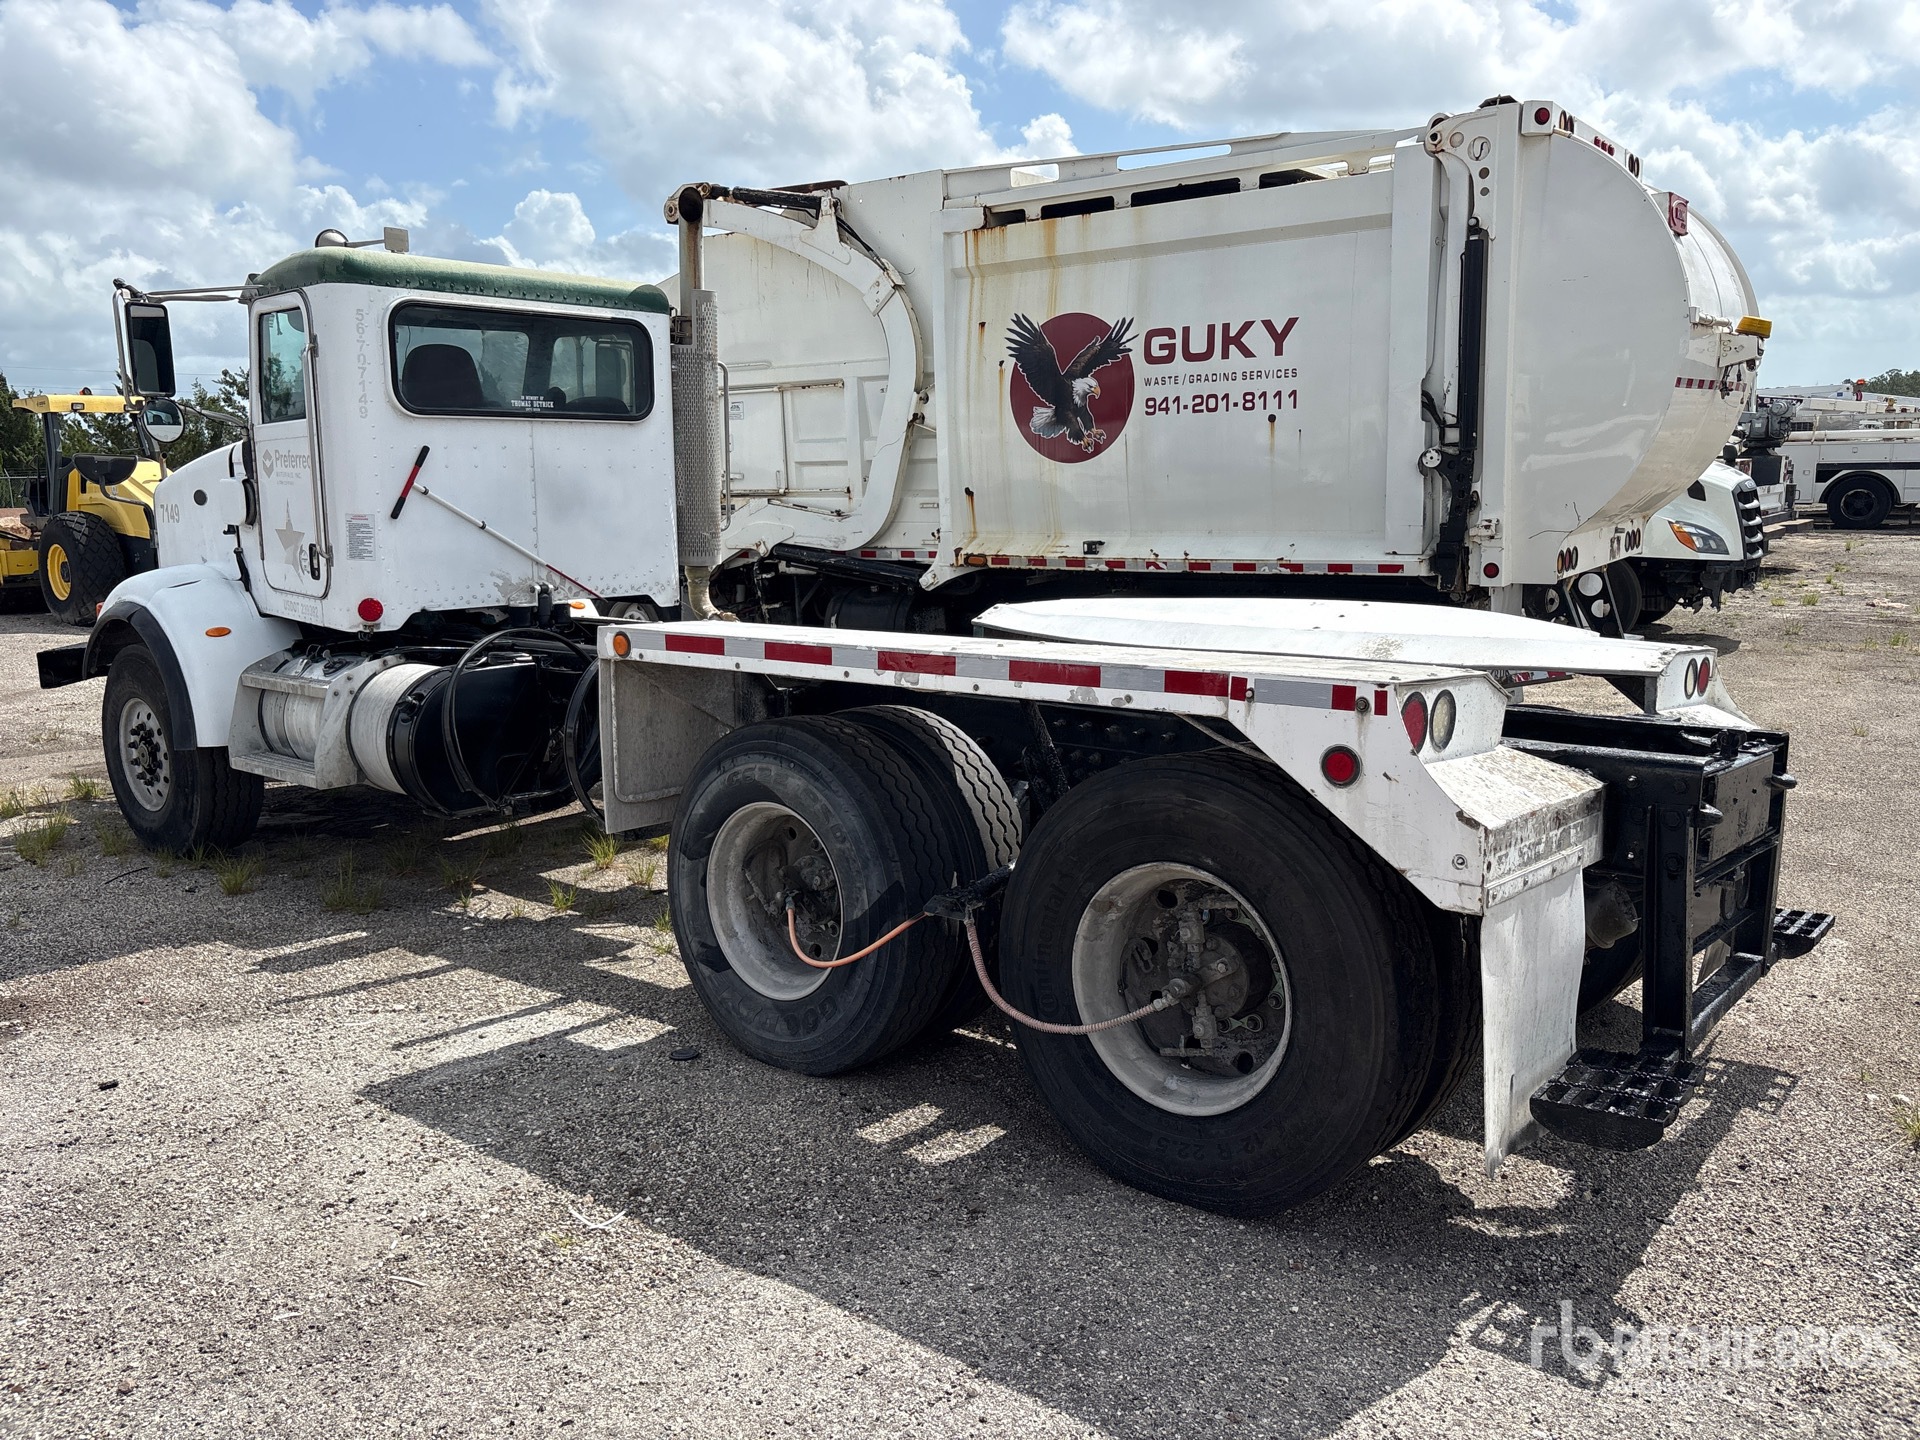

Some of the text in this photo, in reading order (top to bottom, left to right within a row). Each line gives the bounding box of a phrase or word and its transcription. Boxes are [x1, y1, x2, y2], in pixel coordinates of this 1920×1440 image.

[1143, 316, 1300, 366] GUKY
[1241, 367, 1298, 381] SERVICES
[1144, 389, 1298, 416] 941-201-8111
[160, 503, 180, 524] 7149
